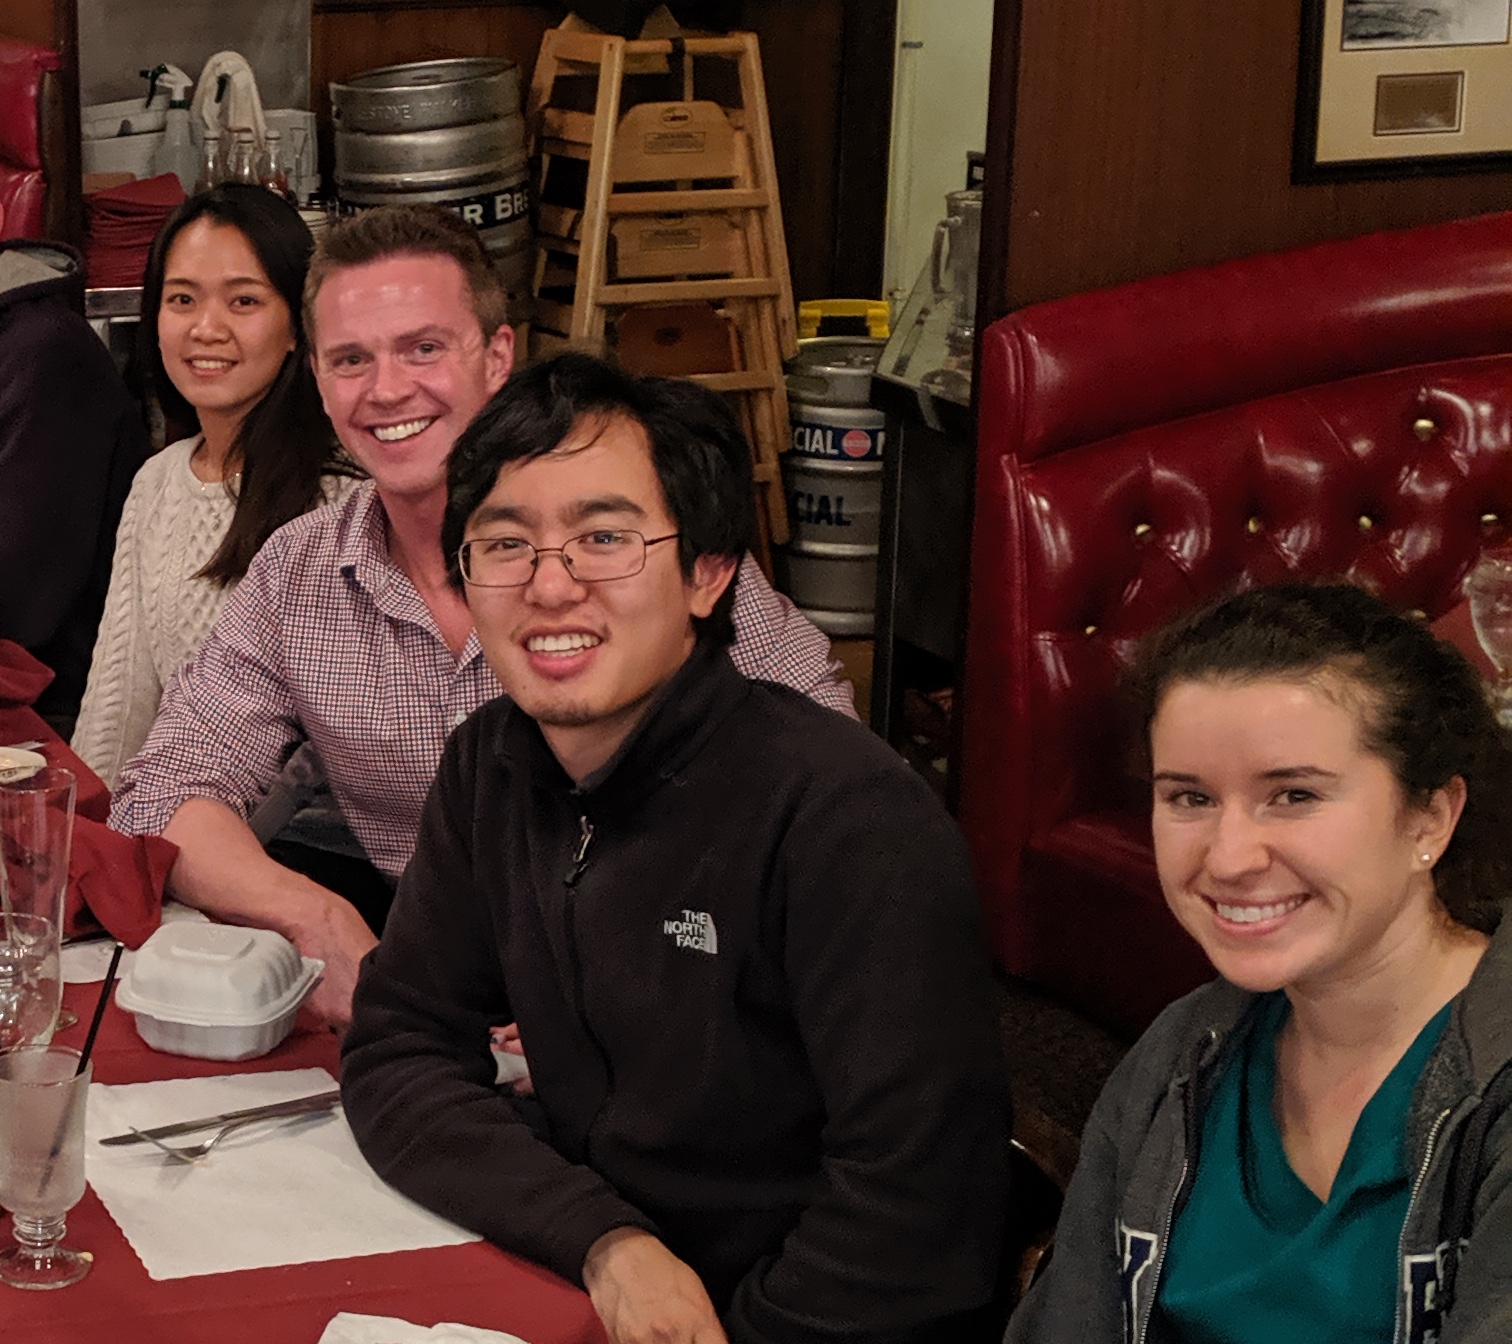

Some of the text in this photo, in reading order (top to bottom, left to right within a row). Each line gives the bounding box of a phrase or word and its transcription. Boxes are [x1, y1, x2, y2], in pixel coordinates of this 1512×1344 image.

[793, 426, 839, 456] CIAL
[793, 491, 852, 527] CIAL
[681, 909, 707, 925] THE
[663, 919, 705, 936] NORTH
[676, 934, 705, 950] FACE
